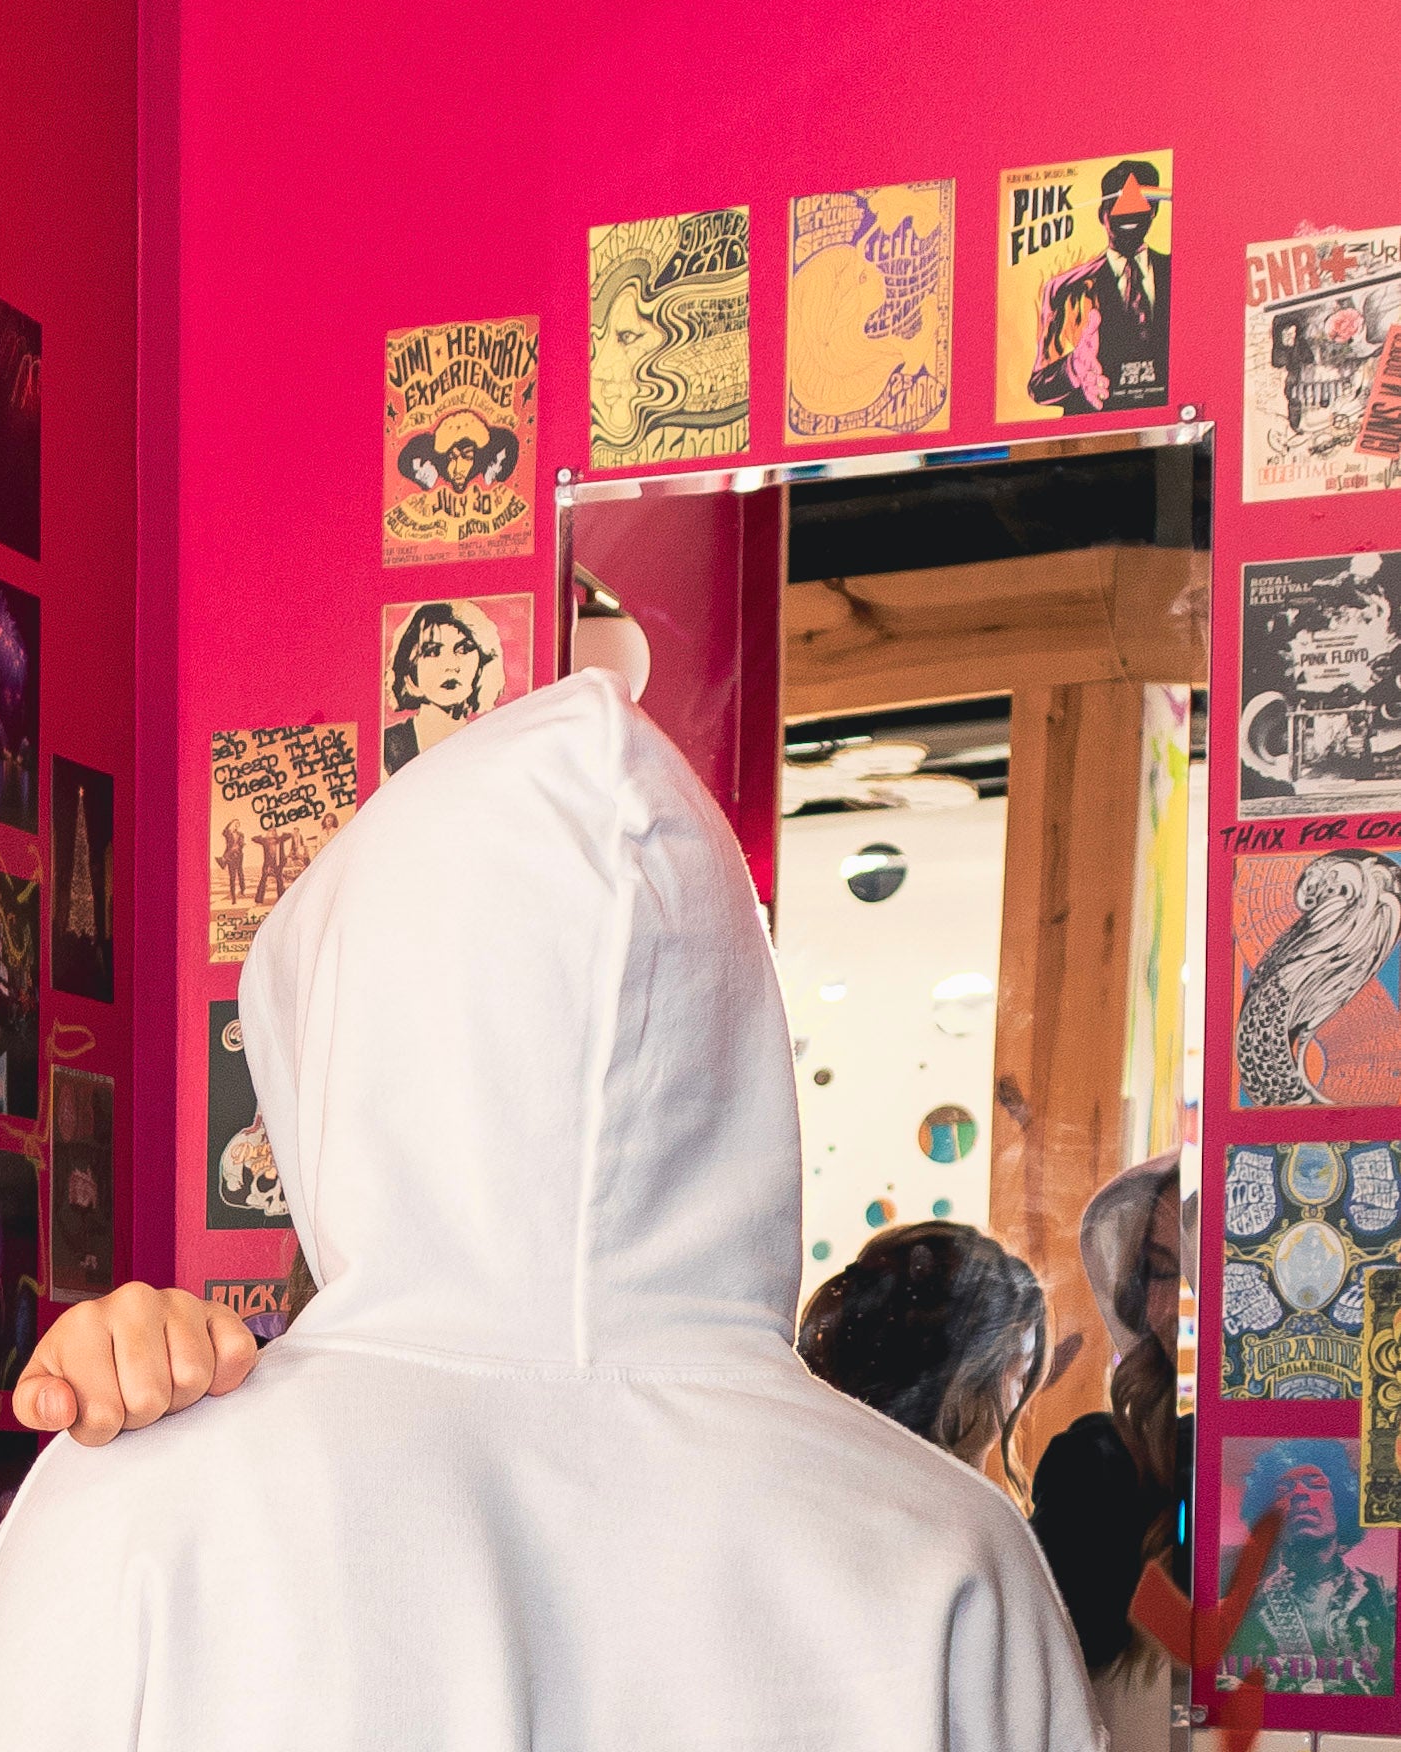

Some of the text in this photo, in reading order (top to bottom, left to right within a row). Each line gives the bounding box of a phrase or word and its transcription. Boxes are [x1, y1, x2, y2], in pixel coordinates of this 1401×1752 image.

[1009, 184, 1074, 229] PINK
[1007, 214, 1075, 268] FLOYD
[388, 325, 539, 388] JIMI HENDRIX
[404, 359, 514, 413] EXPERIENCE
[432, 487, 468, 518] JULY
[472, 484, 492, 515] 30
[1249, 575, 1292, 588] ROYAL
[1249, 582, 1313, 597] FESTIVAL
[1249, 594, 1286, 606] HALL
[1300, 648, 1369, 667] PINK FLOYD
[214, 728, 348, 785] Cheap Trick
[221, 745, 356, 802] Cheap Trick
[251, 782, 317, 815] Cheap
[259, 799, 327, 832] Cheap
[1219, 824, 1287, 852] THNX
[1298, 819, 1349, 846] FOR
